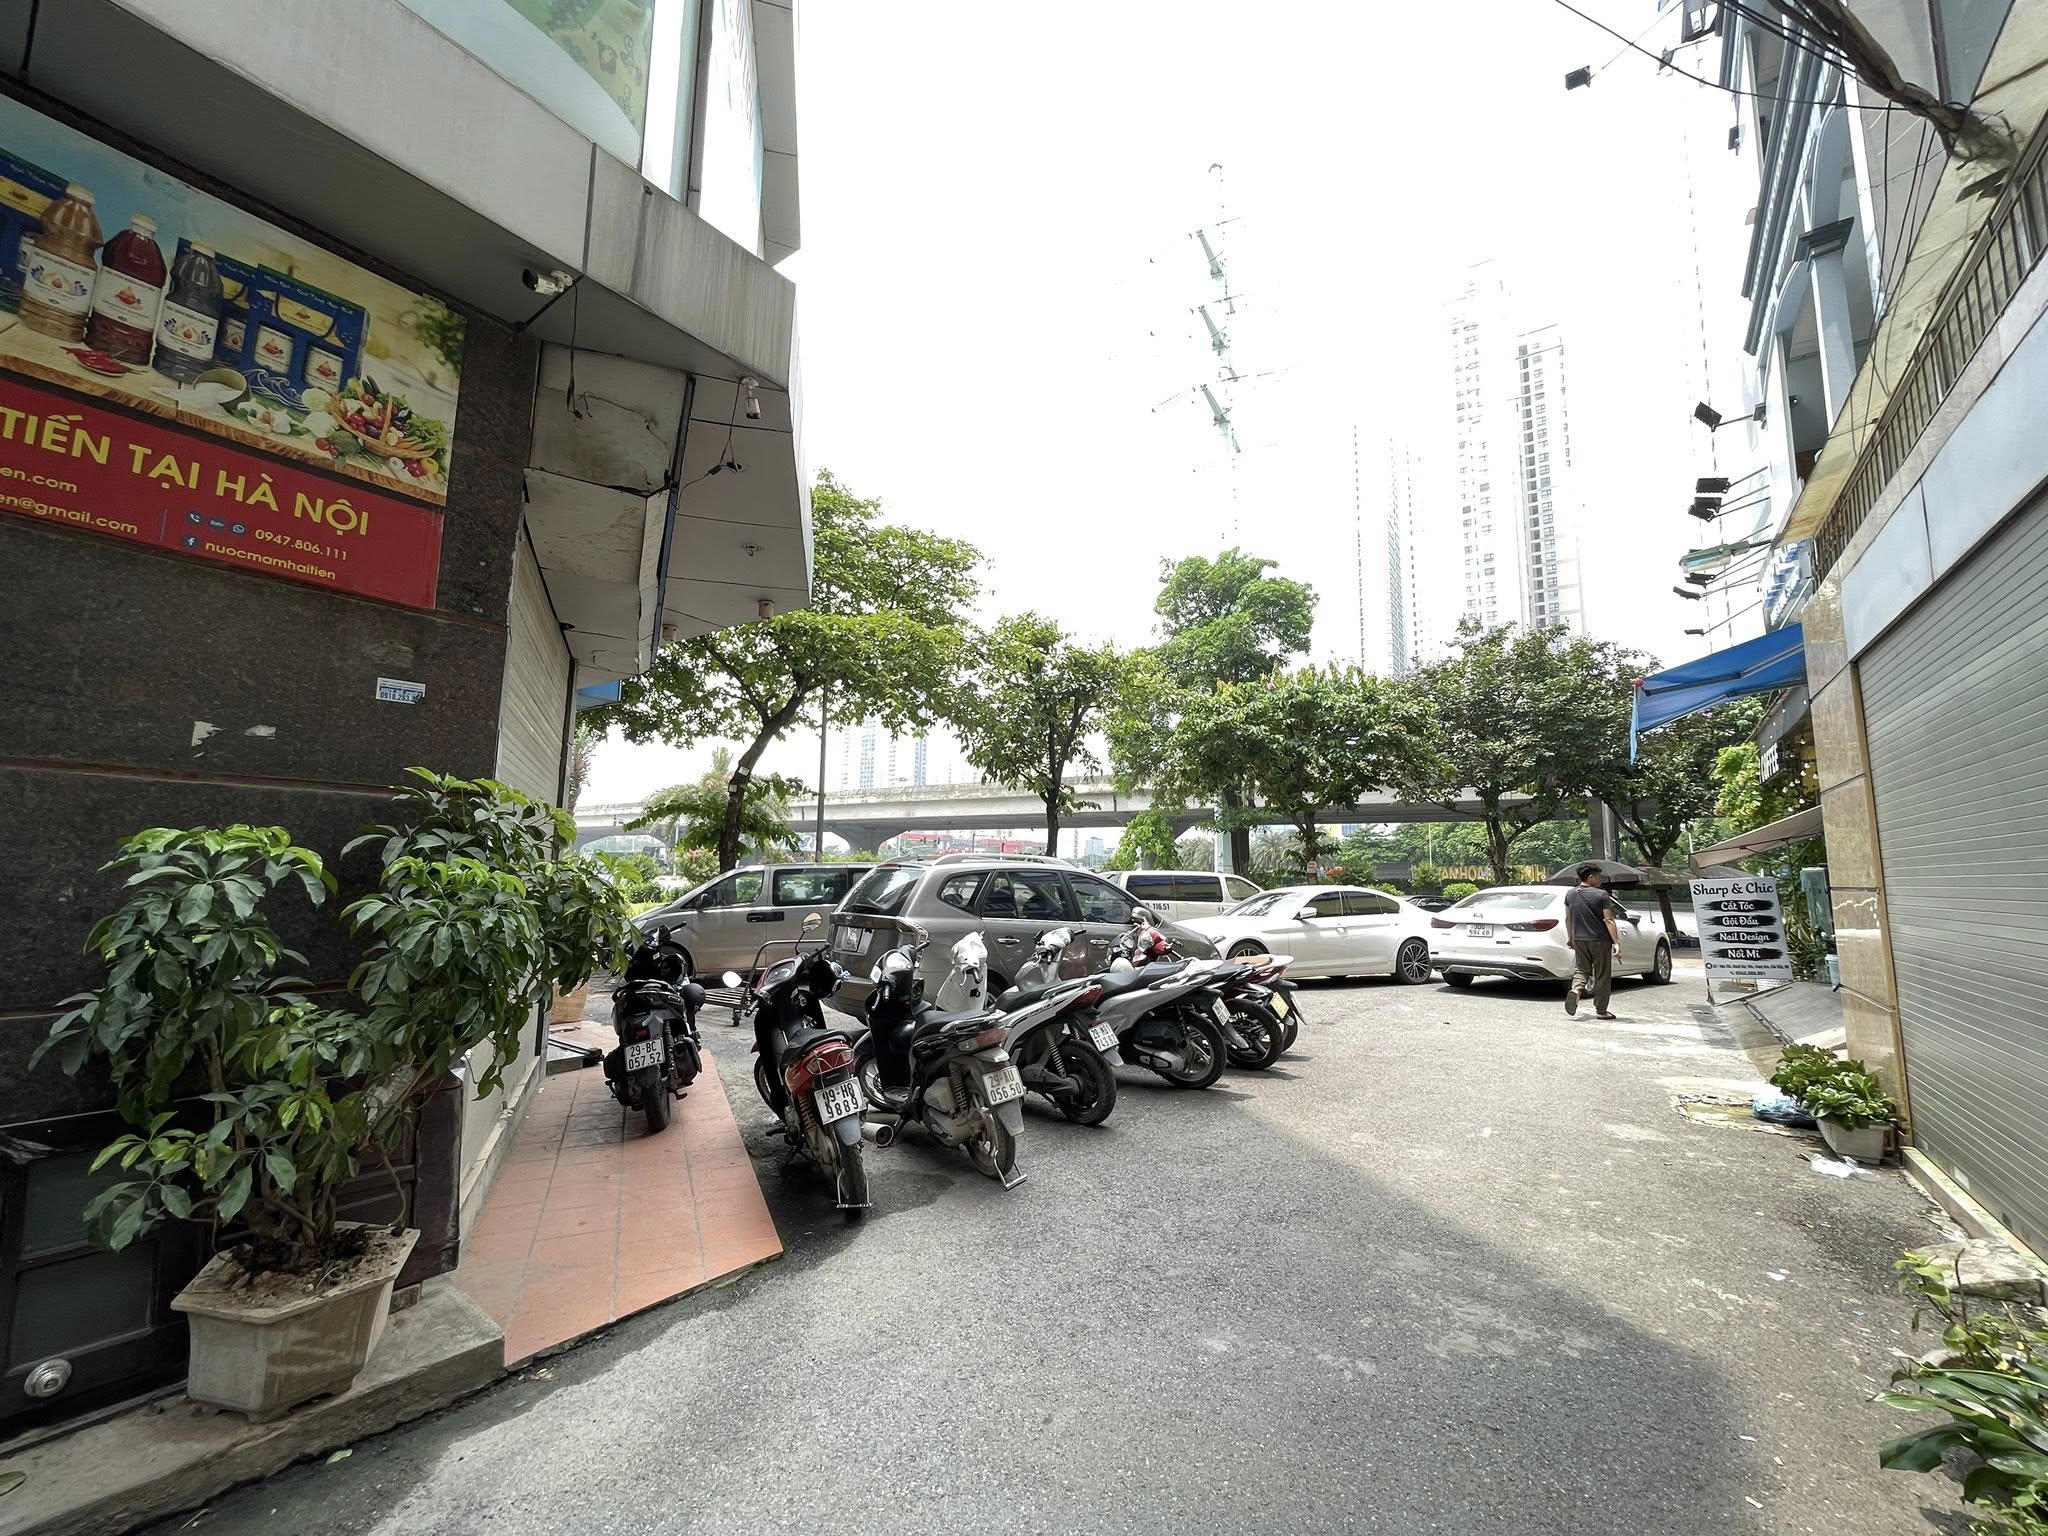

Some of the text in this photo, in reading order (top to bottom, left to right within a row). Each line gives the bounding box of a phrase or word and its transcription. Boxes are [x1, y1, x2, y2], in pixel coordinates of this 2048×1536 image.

[0, 405, 370, 537] TIẾN TẠI HÀ NỘI
[254, 529, 348, 561] 0947.806.111
[205, 541, 337, 581] nuocmamhaitien
[1692, 881, 1775, 898] Sharp & Chic
[1719, 932, 1770, 944] Nail Design
[1746, 949, 1761, 959] Mi
[630, 1041, 657, 1057] 29-BC
[628, 1051, 662, 1070] 057.52
[988, 1069, 1015, 1088] 29-AU
[990, 1081, 1022, 1103] 056.50
[826, 1095, 860, 1119] 9889
